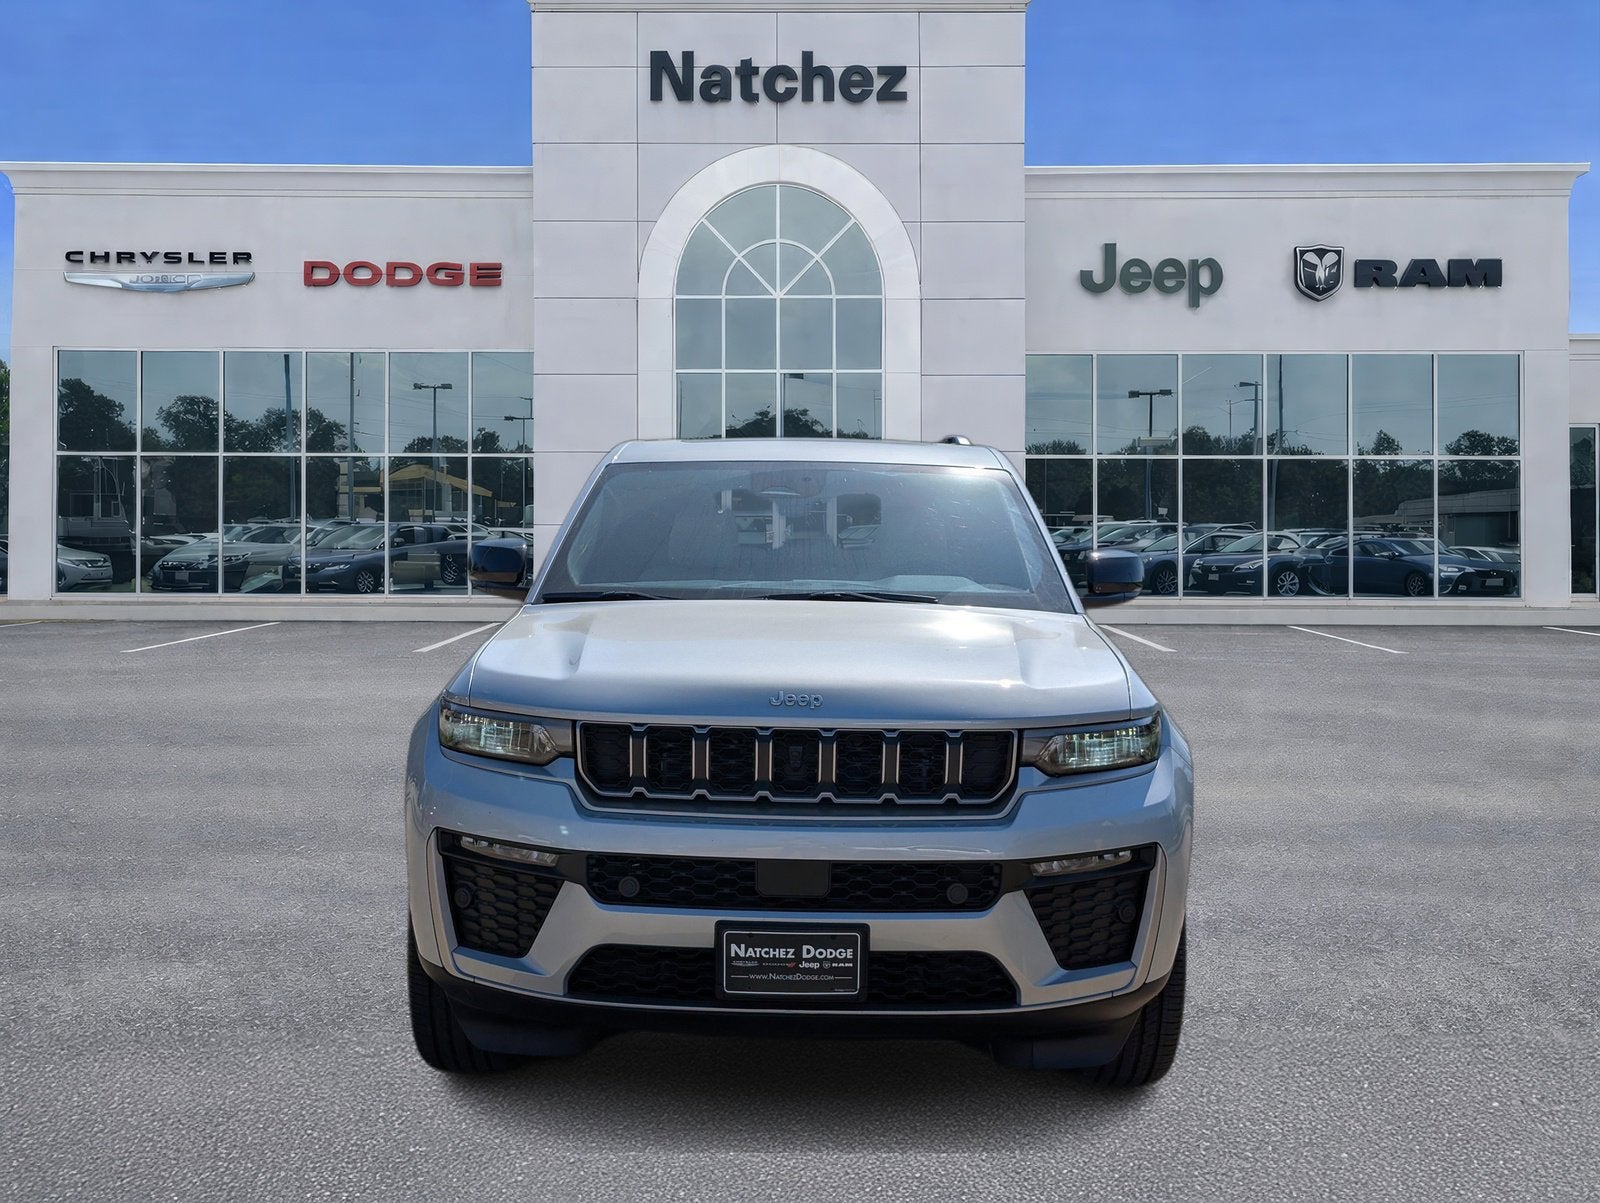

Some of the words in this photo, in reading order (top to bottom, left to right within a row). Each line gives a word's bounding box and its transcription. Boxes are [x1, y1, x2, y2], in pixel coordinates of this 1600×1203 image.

[650, 50, 908, 103] Natchez
[64, 250, 253, 265] CHRYSLER
[303, 260, 503, 287] DODGE
[1079, 243, 1224, 309] Jeep
[1353, 258, 1503, 288] RAM
[768, 690, 824, 709] Jeep
[730, 943, 795, 959] NATCHEZ
[802, 944, 854, 959] DODGE
[798, 960, 820, 969] Jeep
